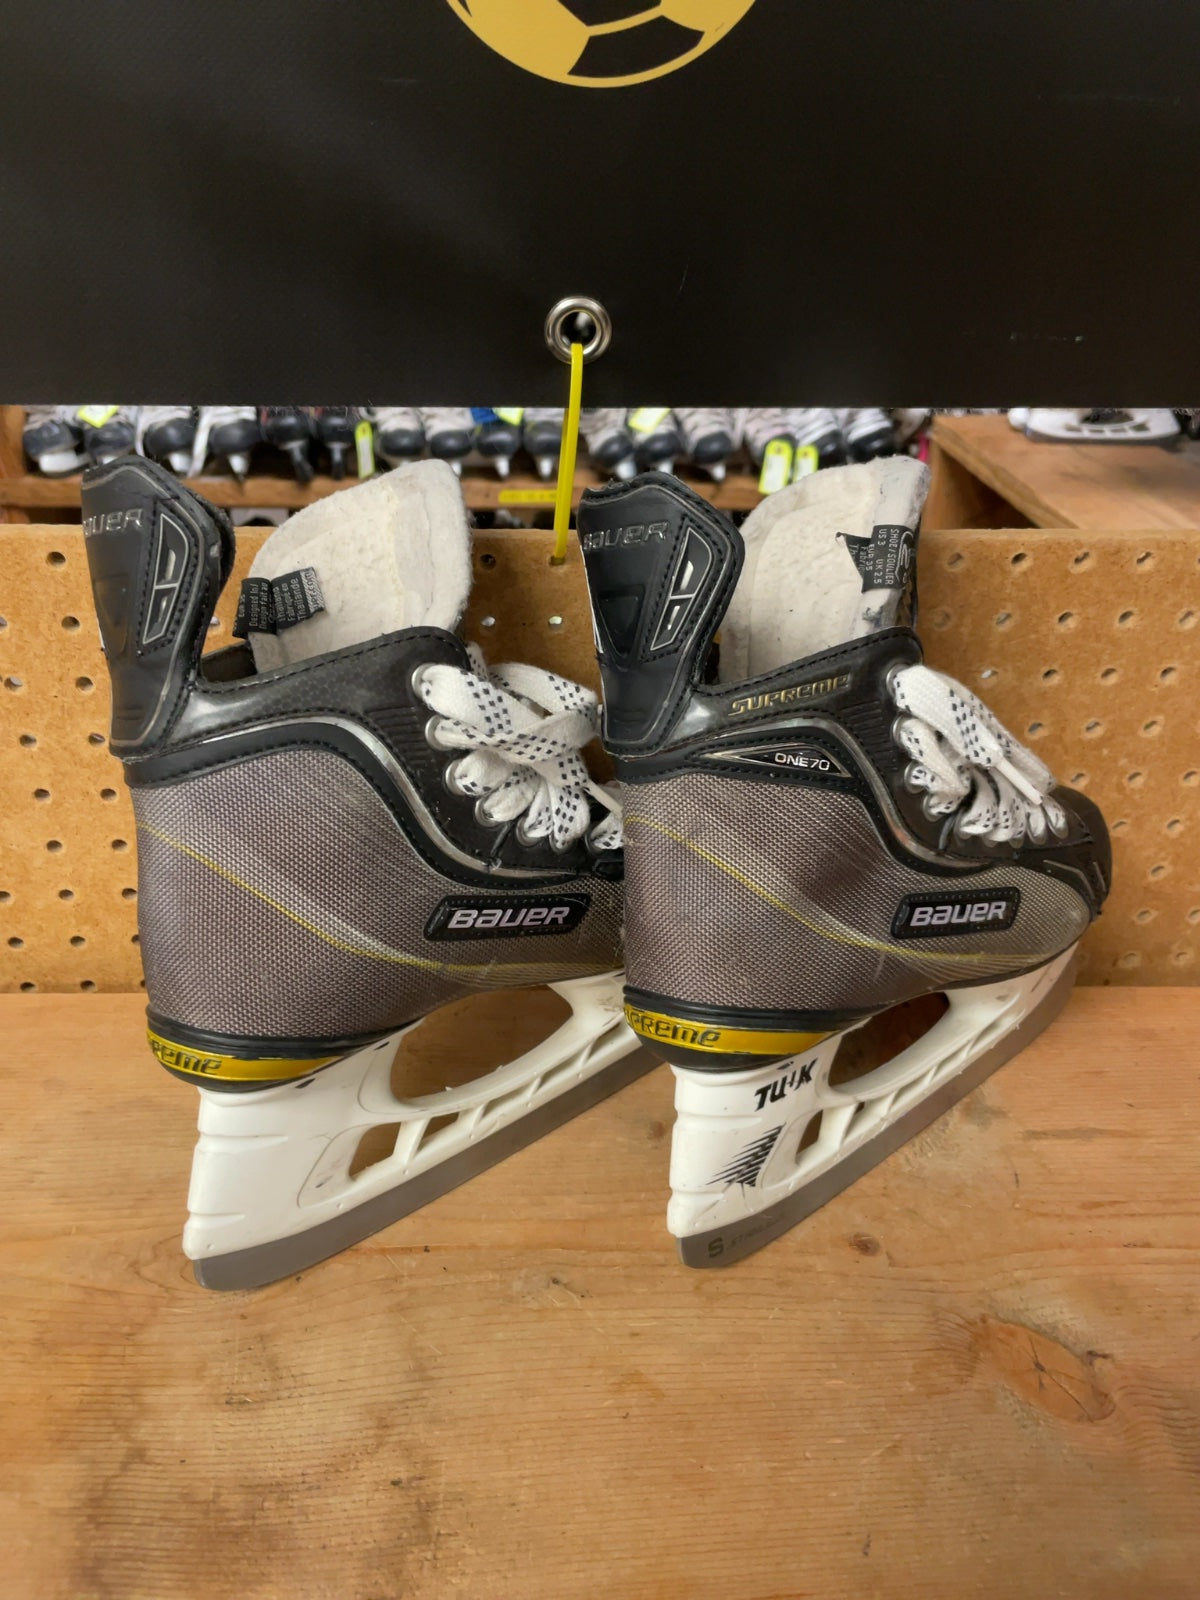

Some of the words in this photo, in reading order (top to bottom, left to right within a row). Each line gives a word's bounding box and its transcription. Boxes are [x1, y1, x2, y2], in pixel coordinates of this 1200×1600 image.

[290, 578, 307, 621] Thailande
[728, 674, 850, 717] SUPREME
[447, 906, 570, 929] BAUER
[910, 901, 1006, 926] BAUER
